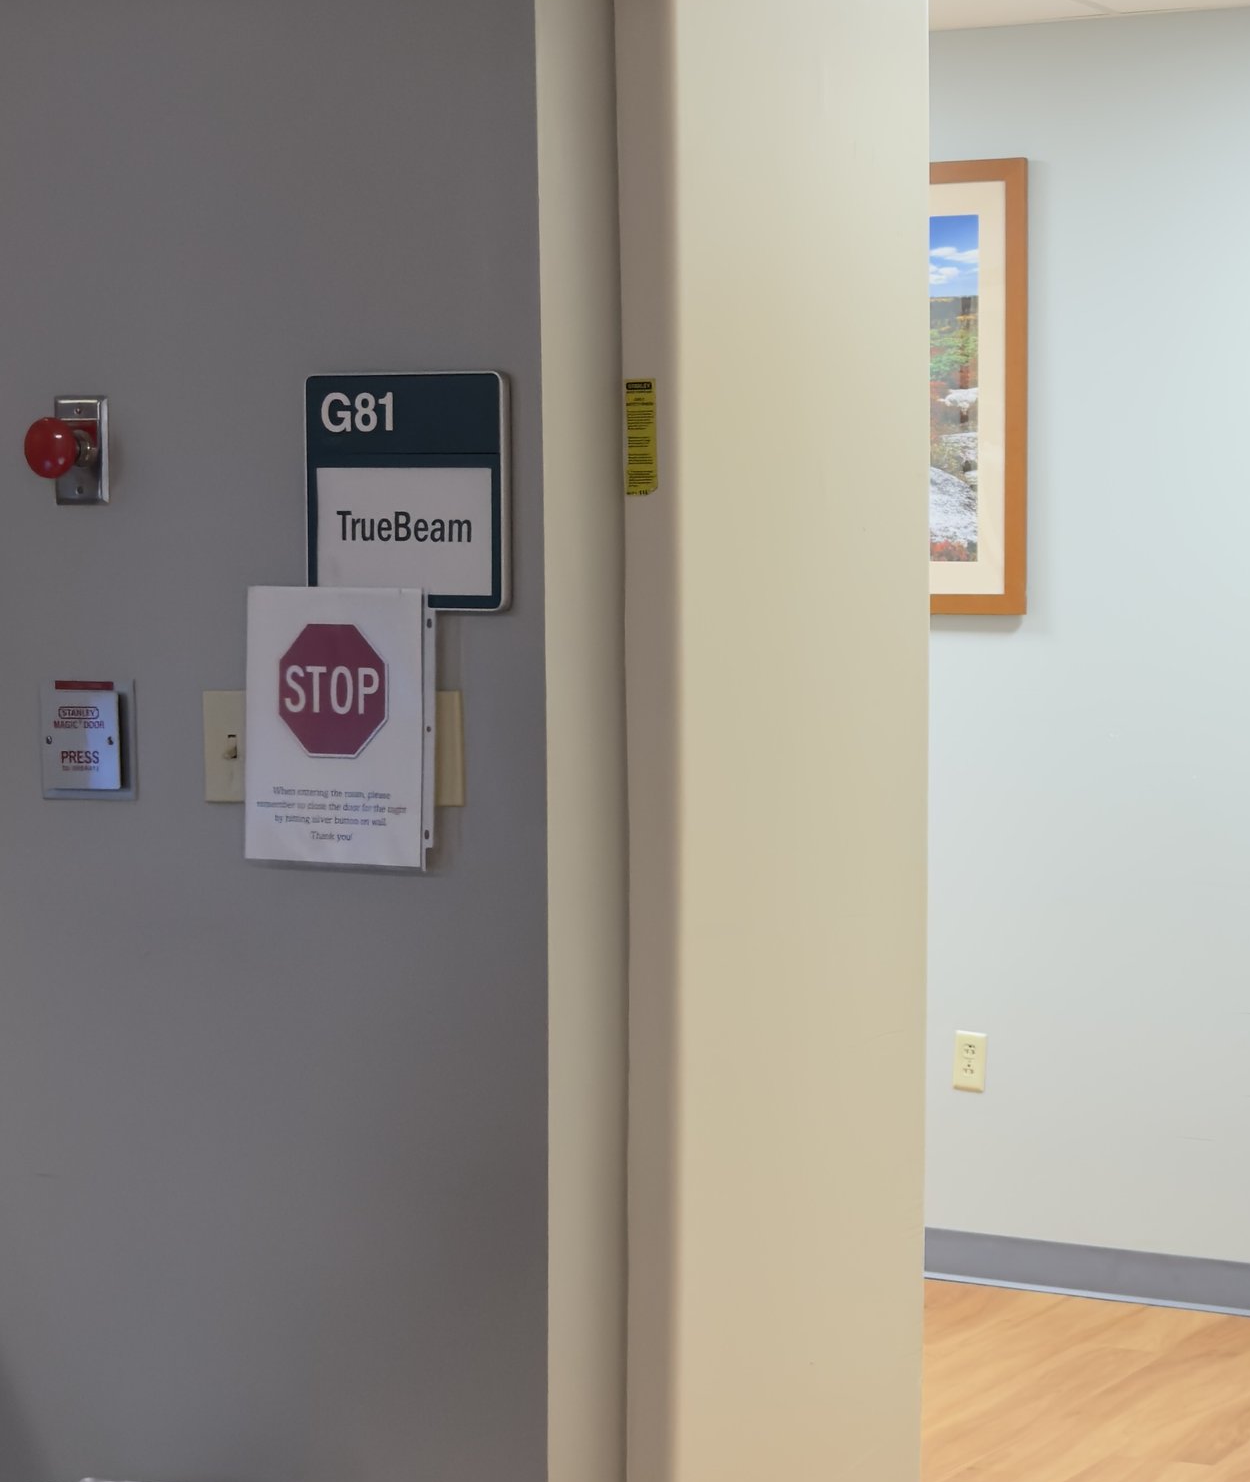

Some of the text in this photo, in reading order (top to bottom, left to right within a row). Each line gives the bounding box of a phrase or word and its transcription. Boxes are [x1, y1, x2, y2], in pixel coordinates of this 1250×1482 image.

[320, 391, 394, 432] G81
[336, 510, 473, 543] TrueBeam
[284, 664, 380, 715] STOP
[61, 750, 100, 764] PRESS
[273, 786, 296, 796] When
[330, 789, 342, 797] the
[310, 830, 335, 840] Thank
